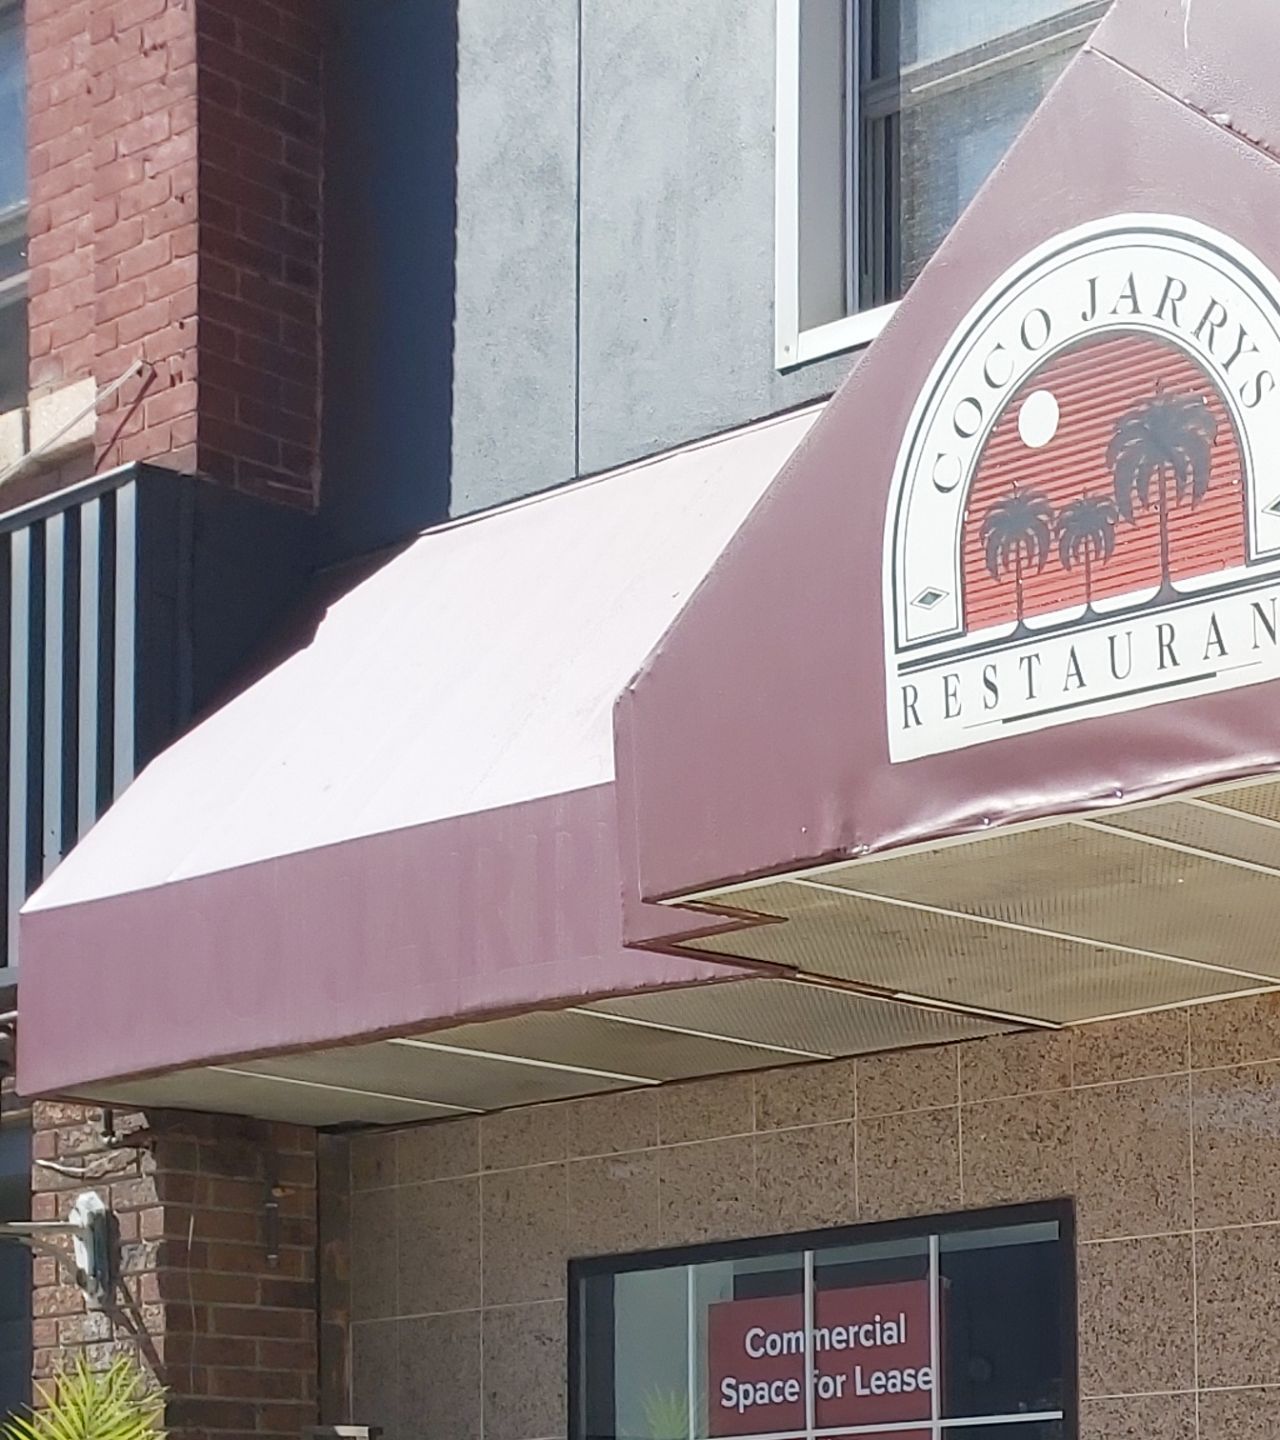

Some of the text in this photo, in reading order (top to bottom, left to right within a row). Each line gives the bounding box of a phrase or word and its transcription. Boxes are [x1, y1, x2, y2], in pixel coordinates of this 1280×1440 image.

[932, 271, 1276, 494] COCO JARRYS
[745, 1313, 906, 1358] Commercial
[720, 1376, 800, 1413] Space
[855, 1365, 933, 1396] Lease
